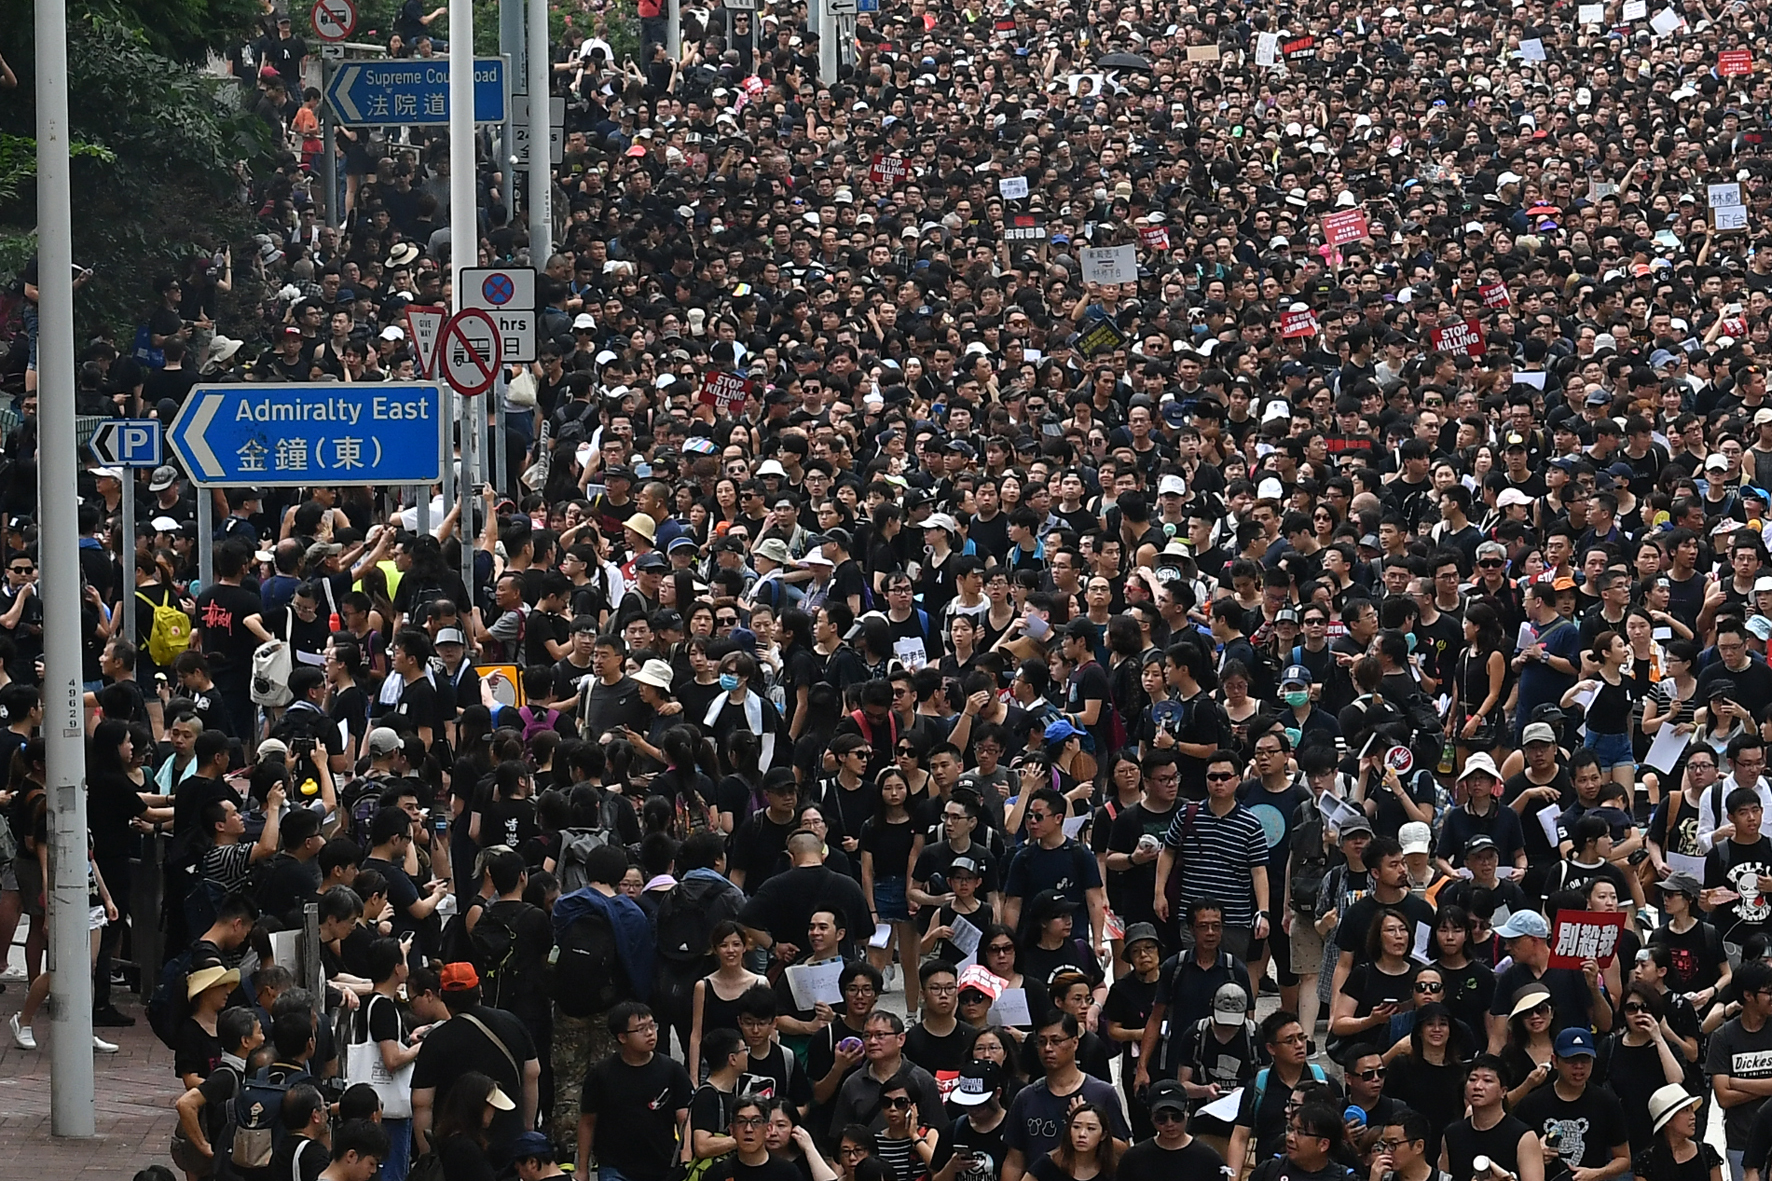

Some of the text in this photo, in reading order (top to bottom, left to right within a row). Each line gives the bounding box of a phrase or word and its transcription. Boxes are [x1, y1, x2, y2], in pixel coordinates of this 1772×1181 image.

[365, 67, 497, 87] Supreme Cou oad
[366, 92, 446, 117] 法院道
[873, 164, 909, 177] KILLING
[881, 157, 903, 167] STOP
[882, 173, 895, 183] US
[1717, 213, 1745, 227] 下台
[418, 319, 432, 329] GIVE
[499, 316, 527, 332] hrs
[1440, 324, 1469, 340] STOP
[419, 330, 431, 338] WAY
[1436, 332, 1480, 352] KILLING
[715, 375, 744, 390] STOP
[705, 382, 746, 401] KILLING
[235, 396, 430, 426] Admiralty East
[715, 397, 730, 408] US
[124, 428, 148, 458] P
[235, 435, 382, 473] 金鐘(東)
[1537, 566, 1557, 583] STOP
[68, 678, 77, 729] 49629
[504, 817, 520, 847] 香港
[1555, 922, 1619, 958] 別殺我
